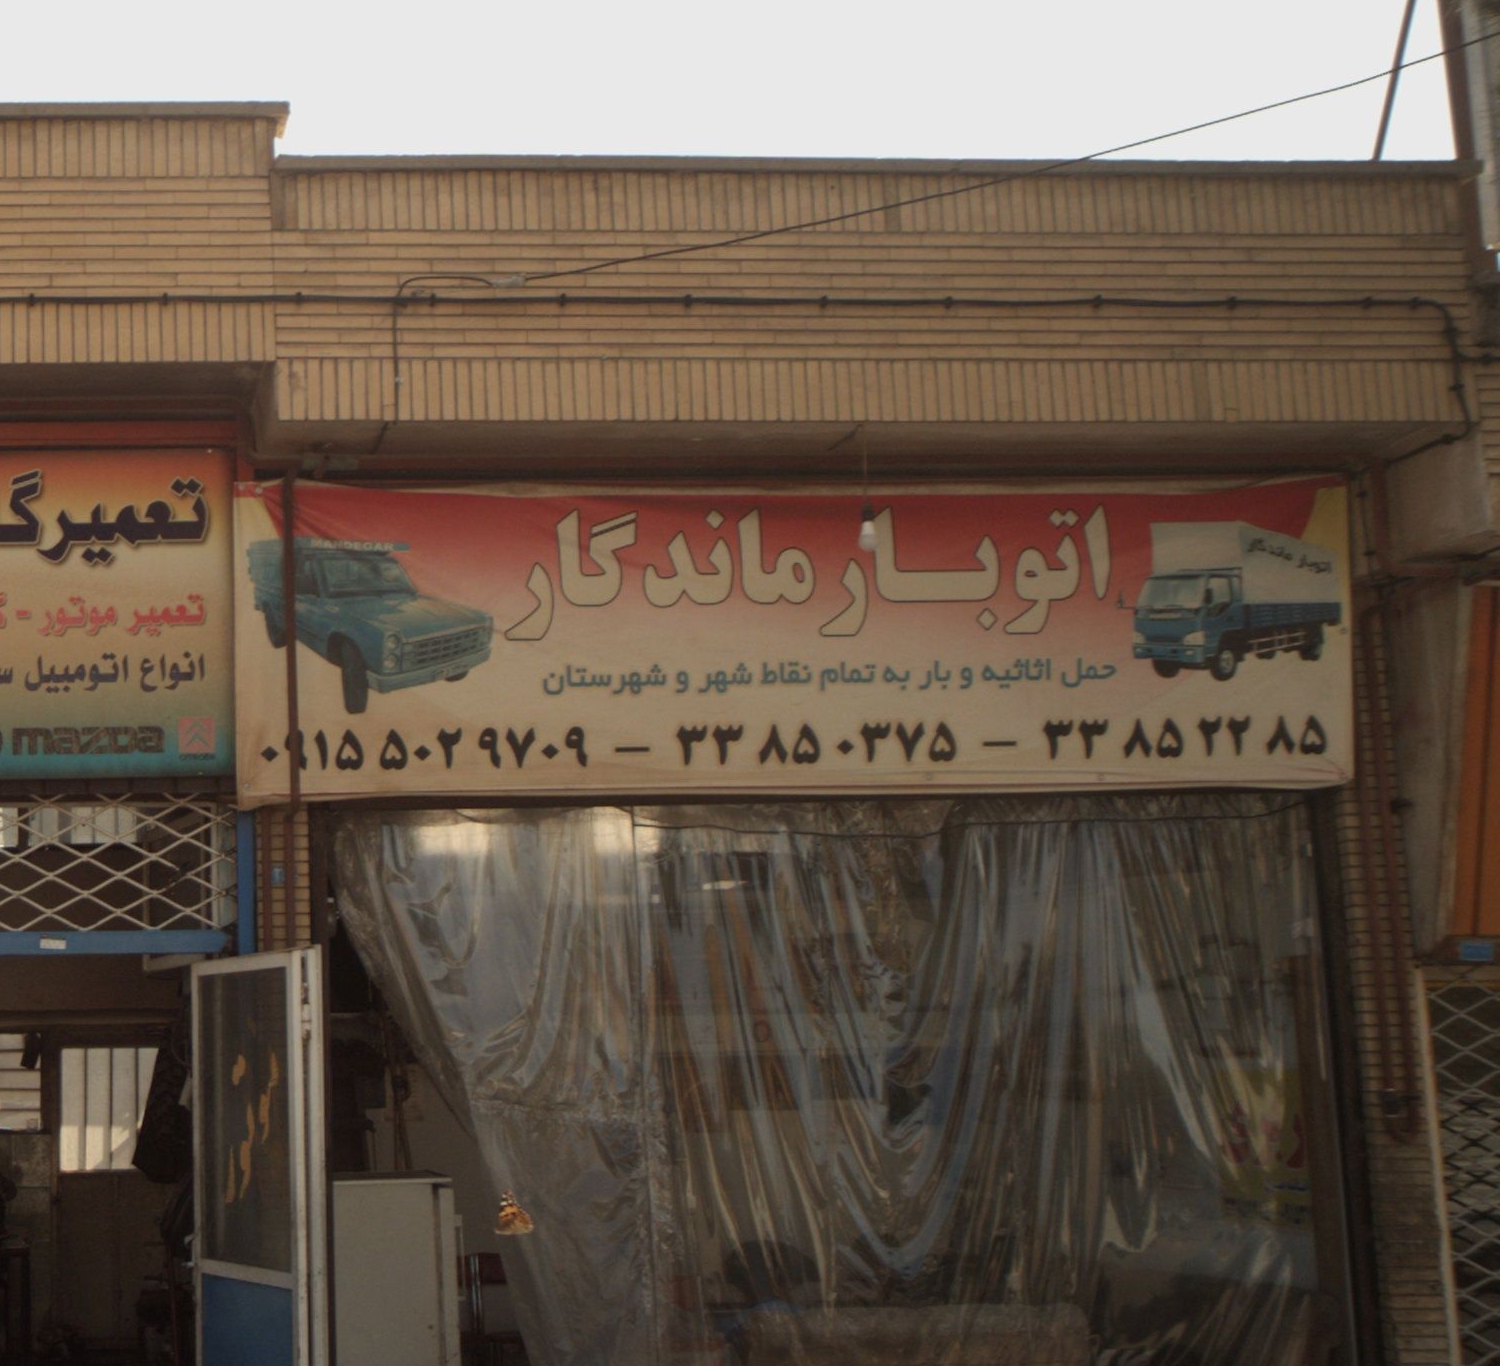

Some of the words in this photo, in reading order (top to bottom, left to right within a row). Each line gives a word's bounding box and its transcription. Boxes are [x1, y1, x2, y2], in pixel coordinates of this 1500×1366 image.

[503, 507, 816, 641] ماندگار
[818, 504, 1112, 637] اتوبار
[38, 597, 118, 637] موتور
[125, 594, 206, 640] تعمیر
[22, 652, 128, 692] اتومبیل
[138, 651, 206, 691] انواع
[542, 663, 668, 695] شهرستان
[675, 672, 690, 694] و
[698, 663, 752, 693] شهر
[760, 662, 811, 686] نقاط
[818, 662, 876, 695] تمام
[881, 662, 911, 692] به
[917, 660, 952, 691] بار
[959, 666, 973, 688] و
[981, 658, 1052, 688] اثاثیه
[1060, 658, 1119, 688] حمل
